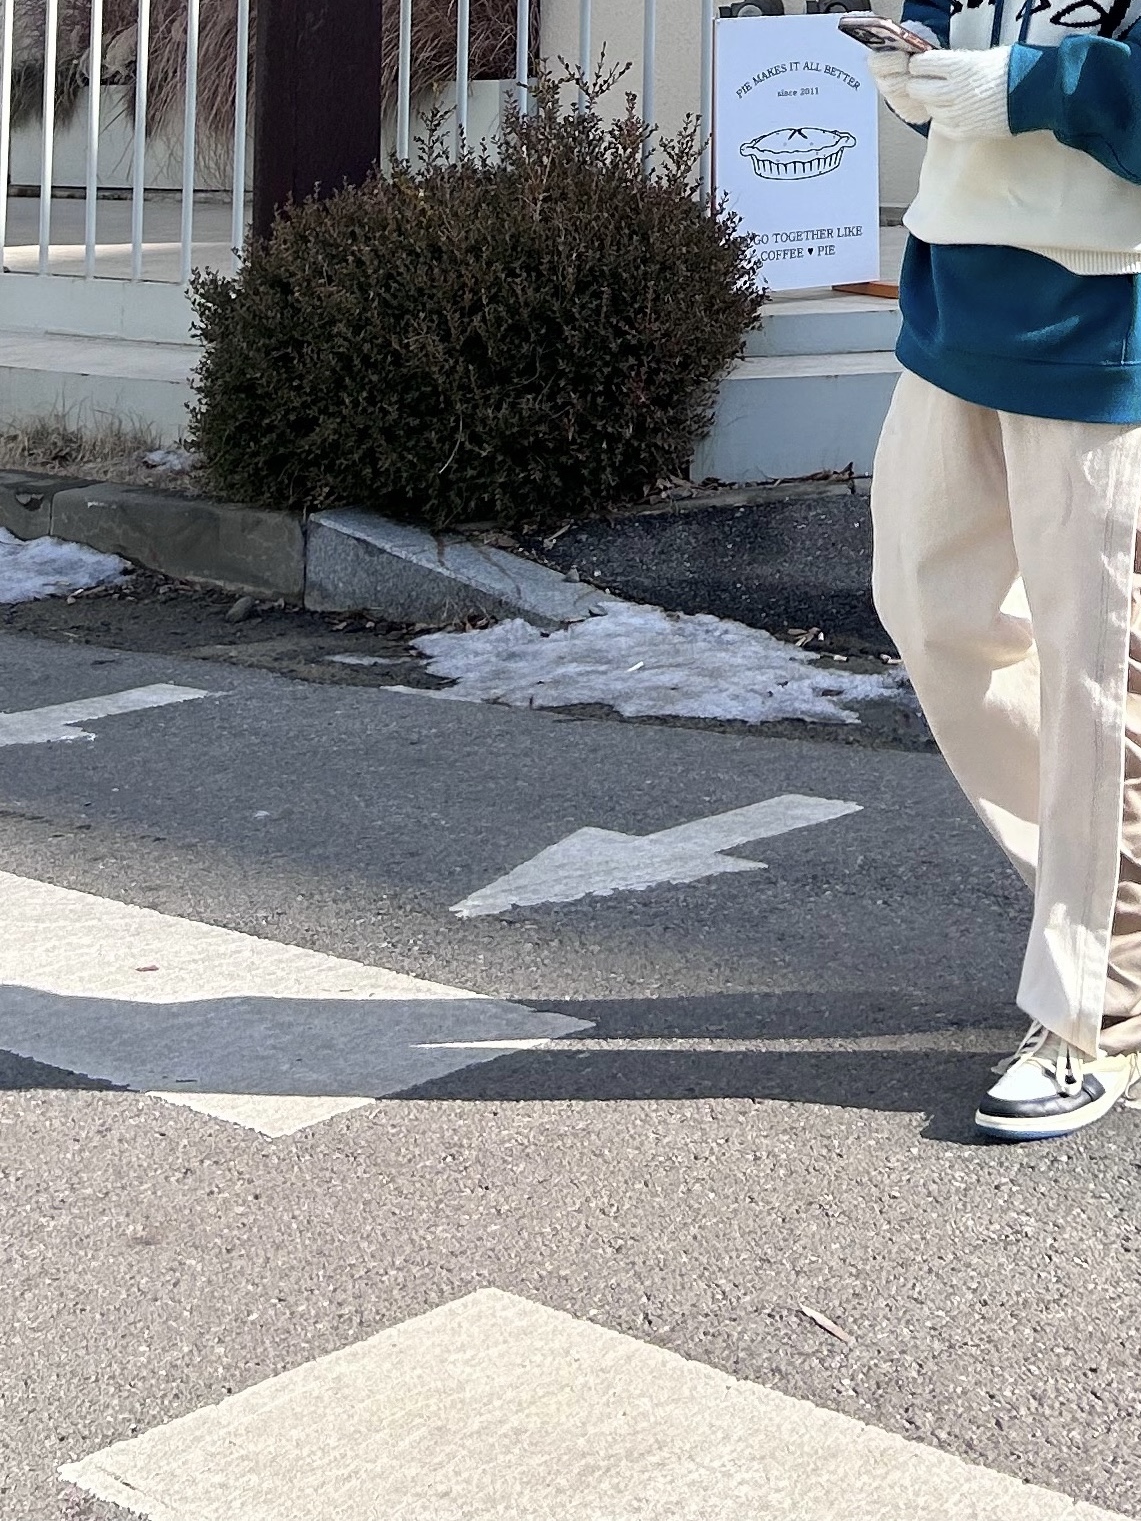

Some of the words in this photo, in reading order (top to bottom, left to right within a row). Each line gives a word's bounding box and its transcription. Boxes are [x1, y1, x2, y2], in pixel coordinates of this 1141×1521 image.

[736, 81, 752, 99] PIE
[752, 63, 788, 86] MAKES
[789, 61, 801, 72] IT
[802, 60, 822, 72] ALL
[823, 64, 861, 92] BETTER
[777, 89, 798, 97] since
[799, 87, 819, 96] 2011
[753, 233, 769, 245] GO
[771, 228, 834, 244] TOGETHER
[836, 225, 863, 238] LIKE
[760, 247, 804, 262] COFFEE
[817, 244, 836, 257] PIE
